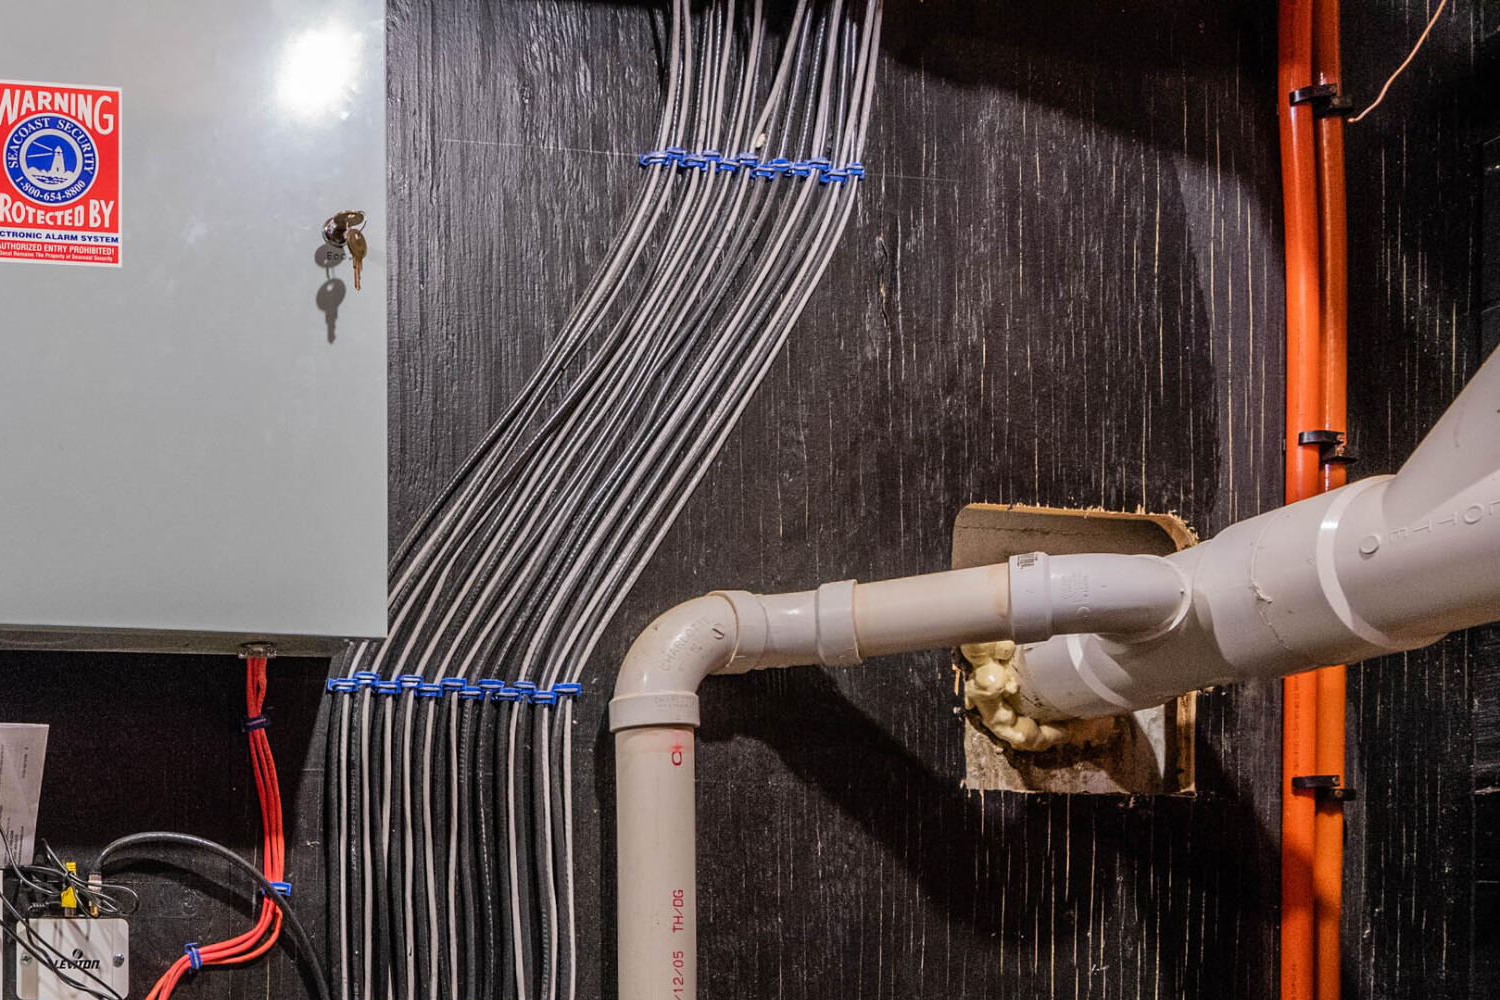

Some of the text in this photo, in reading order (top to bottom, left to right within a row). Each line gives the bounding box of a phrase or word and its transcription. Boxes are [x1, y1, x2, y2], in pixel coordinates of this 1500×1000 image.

[6, 117, 95, 174] SEACOAST SECURITY
[15, 175, 86, 202] 1-800-654-8800
[89, 199, 115, 228] BY
[43, 244, 67, 253] ENTRY
[68, 245, 114, 255] PROHIBITED!
[44, 232, 78, 241] ALARM
[80, 234, 119, 243] SYSTEM
[672, 889, 684, 933] TH/DG
